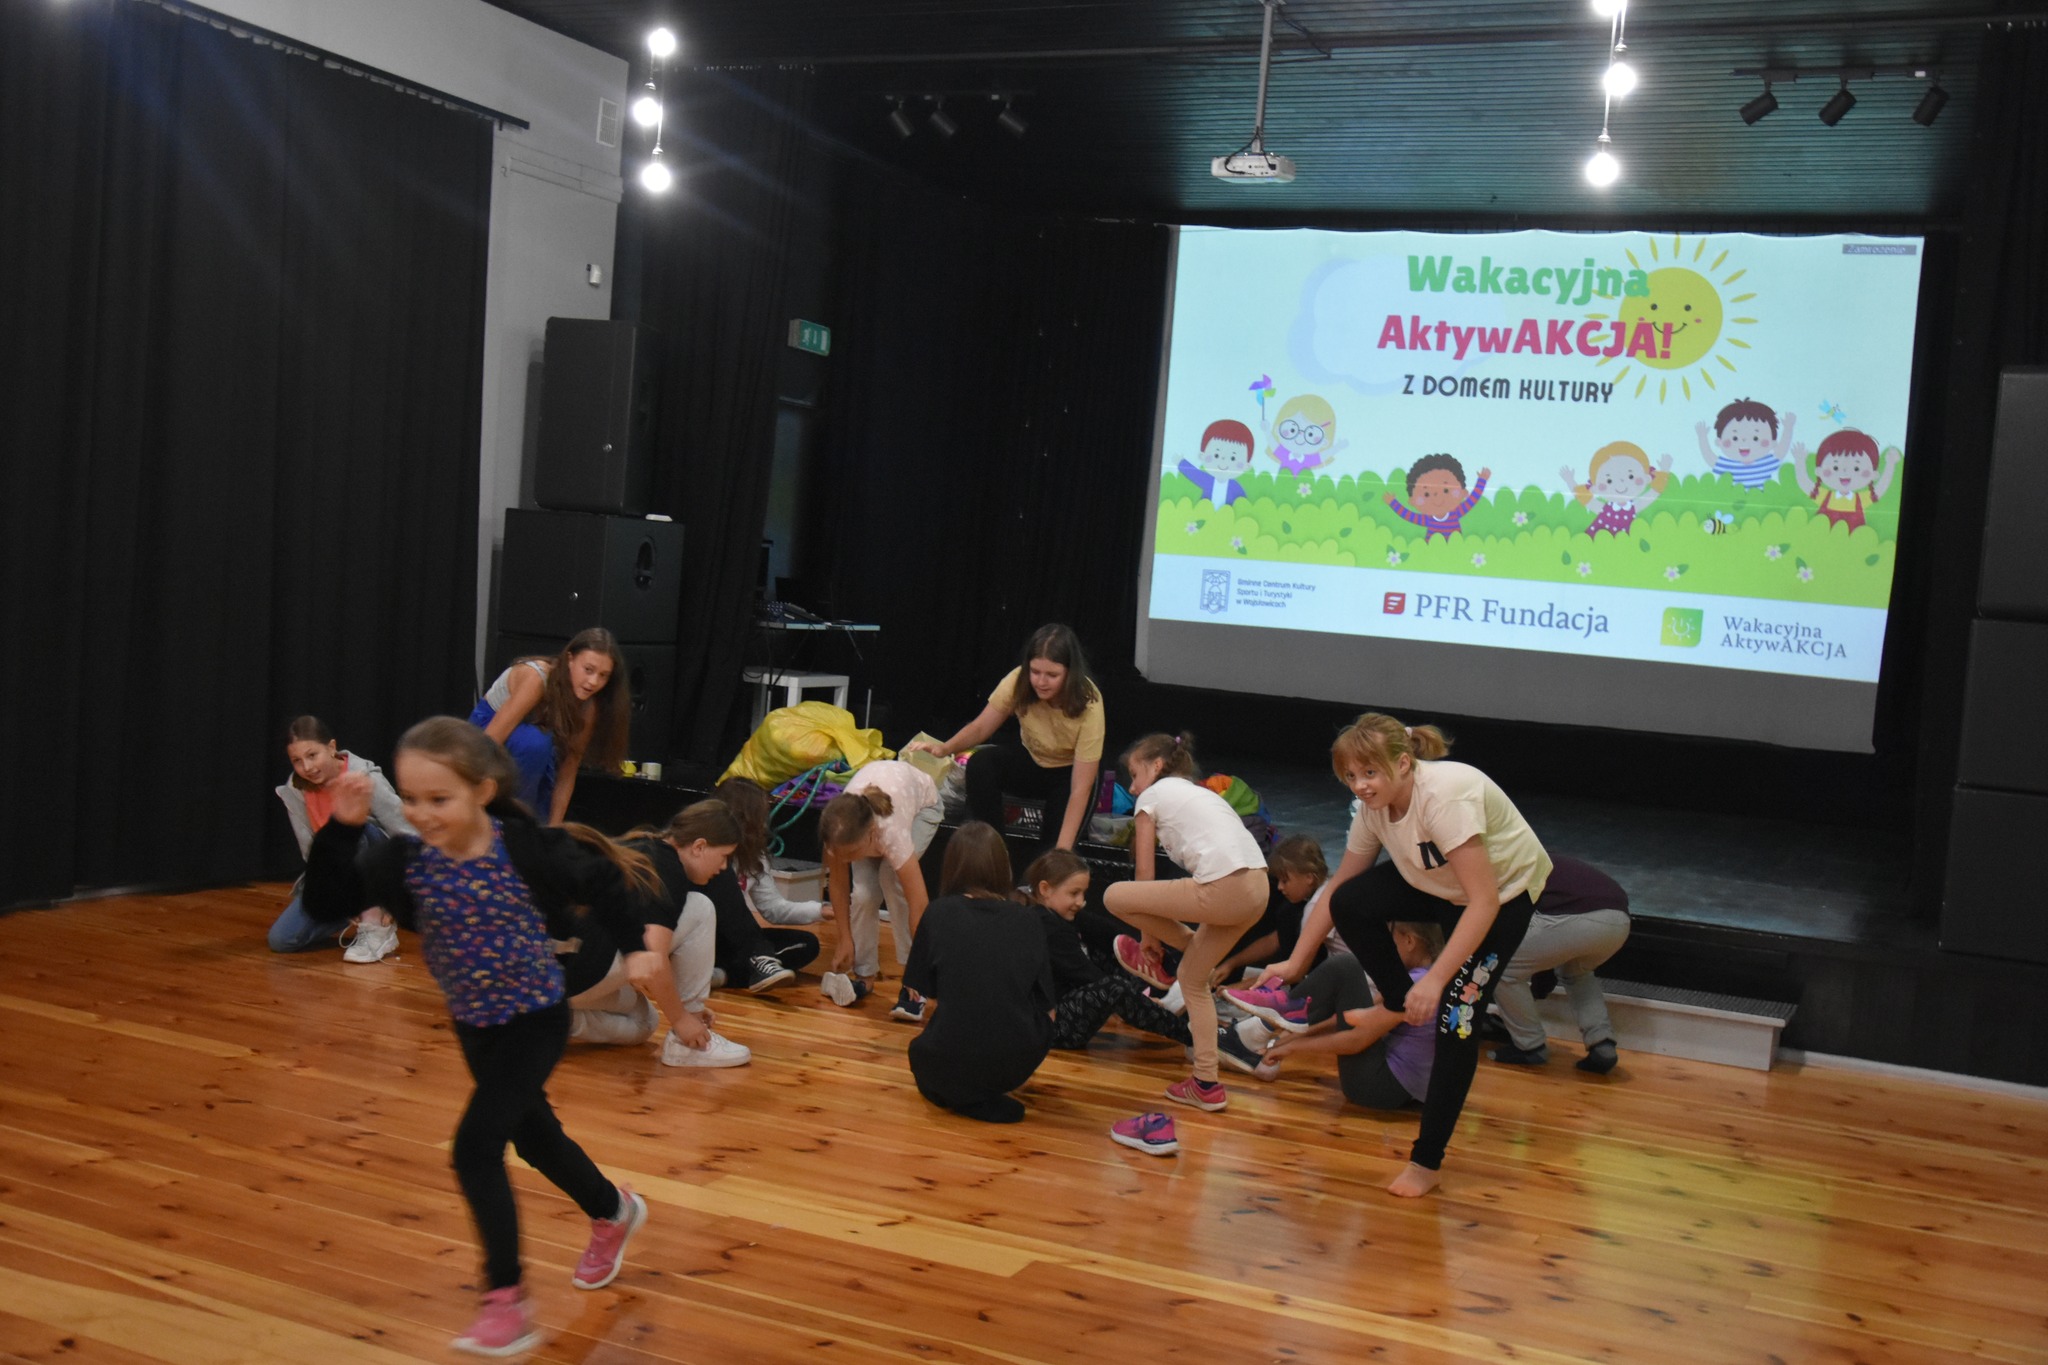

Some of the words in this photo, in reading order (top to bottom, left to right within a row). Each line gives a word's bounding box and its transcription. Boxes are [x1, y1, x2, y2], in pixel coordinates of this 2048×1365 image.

[1407, 255, 1651, 306] Wakacyjna
[1377, 314, 1674, 360] AktywAKCJA!
[1402, 374, 1415, 396] Z
[1422, 375, 1511, 399] DOMEM
[1519, 379, 1614, 404] KULTURY
[1236, 588, 1258, 596] Sportu
[1264, 590, 1293, 599] Turystyki
[1263, 580, 1291, 588] Centrum
[1292, 582, 1316, 592] Kultury
[1414, 593, 1474, 622] PFR
[1481, 599, 1610, 639] Fundacja
[1723, 615, 1823, 640] Wakacyjna
[1720, 633, 1847, 660] AktywAKCJA
